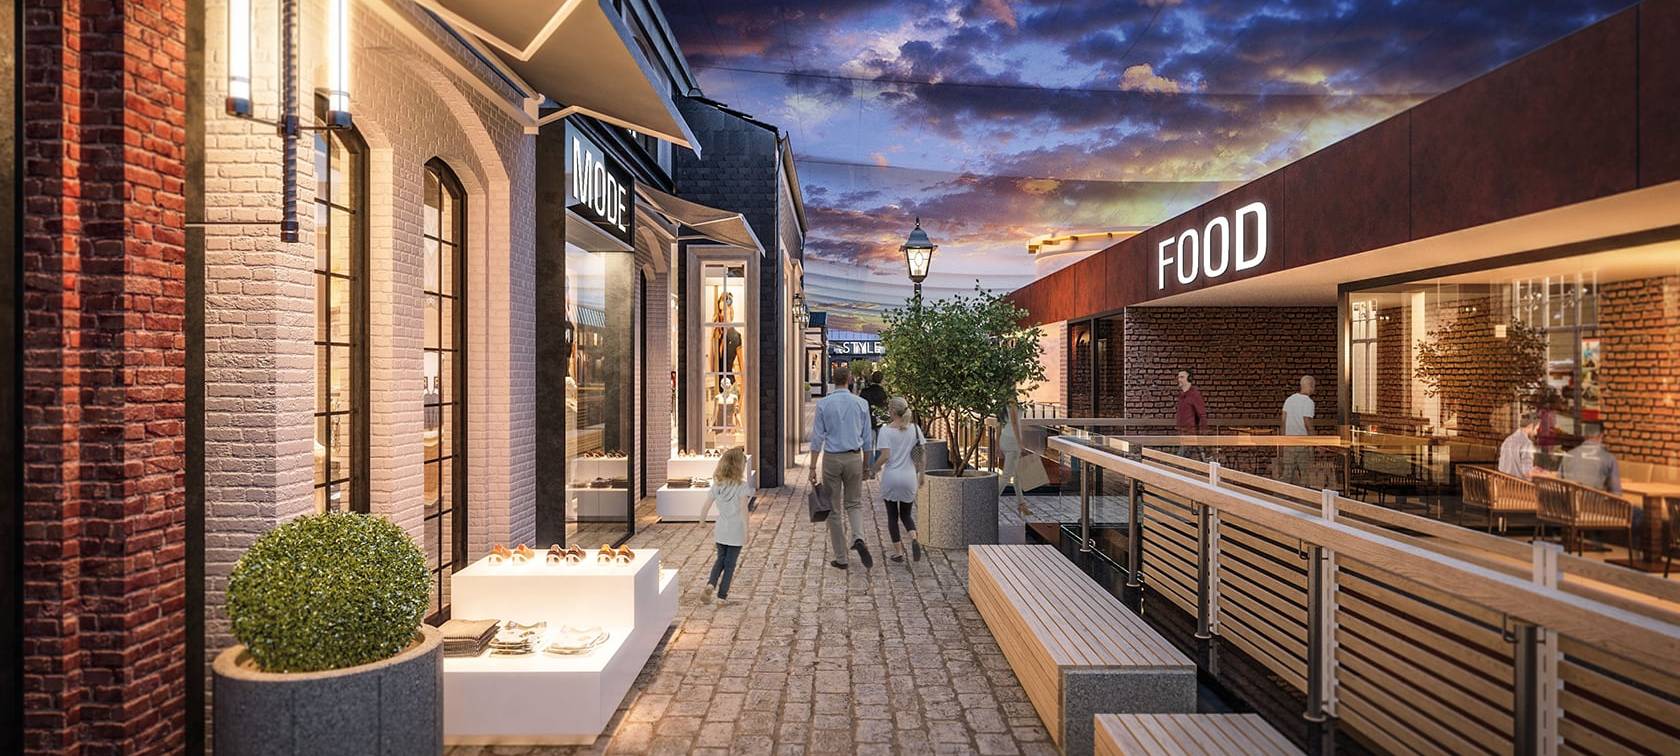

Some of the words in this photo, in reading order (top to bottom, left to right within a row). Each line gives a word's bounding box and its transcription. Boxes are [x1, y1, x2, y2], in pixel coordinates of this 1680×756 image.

[573, 136, 626, 232] MODE
[1158, 201, 1268, 291] FOOD
[843, 341, 881, 354] STYLE
